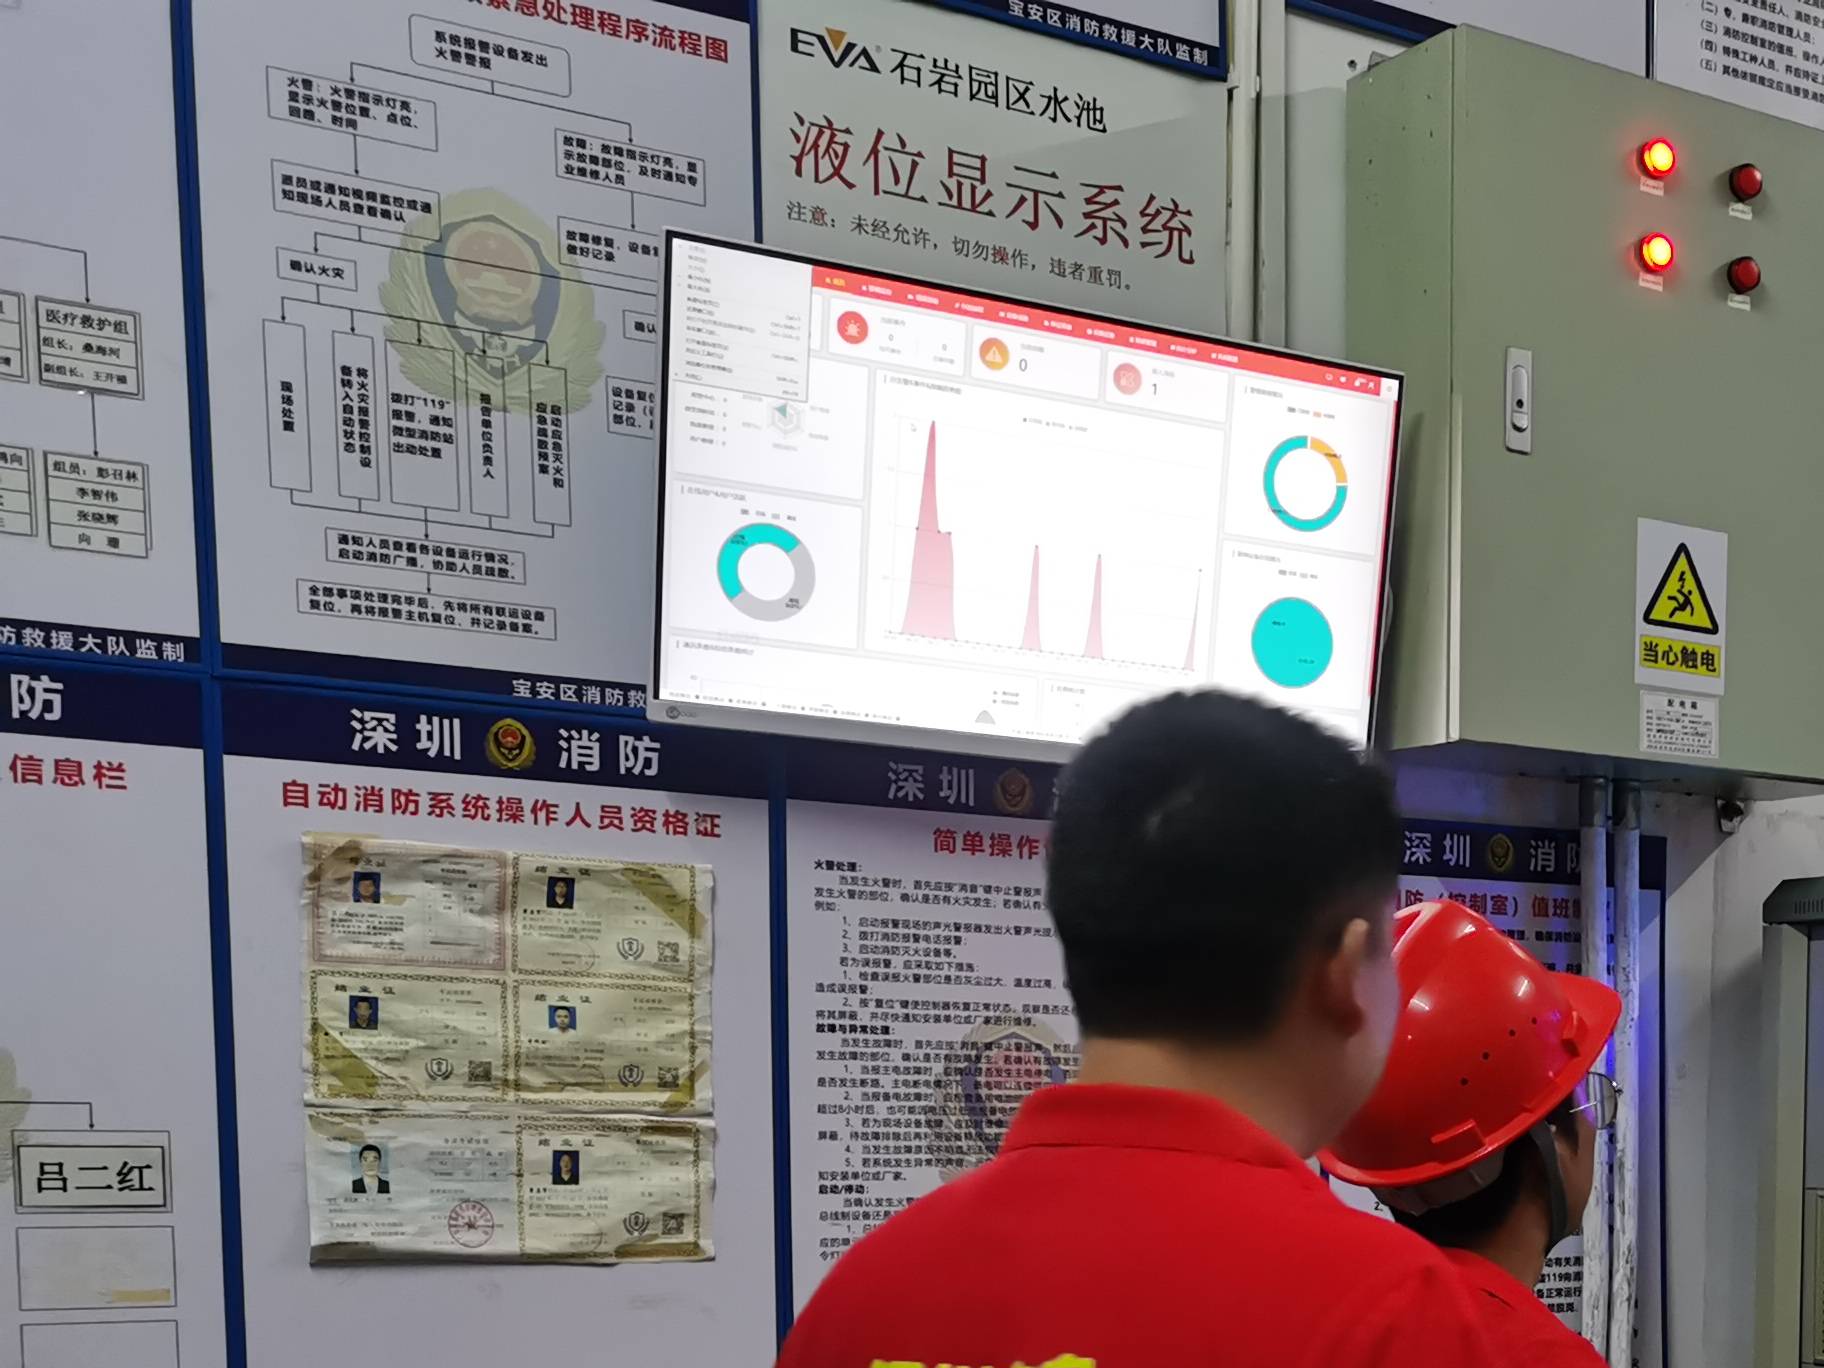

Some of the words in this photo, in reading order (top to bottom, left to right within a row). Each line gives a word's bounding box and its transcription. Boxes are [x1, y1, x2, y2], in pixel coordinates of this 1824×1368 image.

[1007, 0, 1210, 68] 宝安区消防救援大队监制
[890, 46, 1108, 133] 石岩园区水池
[789, 111, 1196, 265] 液位显示系统
[786, 200, 1136, 292] 注意：未经允许，切勿操作，违者重罚。
[1643, 640, 1717, 674] 当心触电
[10, 673, 64, 721] 防
[349, 708, 463, 761] 深圳
[557, 729, 662, 777] 消防
[9, 753, 128, 790] 信息栏
[887, 759, 977, 808] 深圳
[281, 779, 723, 840] 自动消防系统操作人员资格证
[932, 826, 1054, 862] 简单操作
[1403, 831, 1471, 868] 深圳
[34, 1158, 155, 1196] 吕二红
